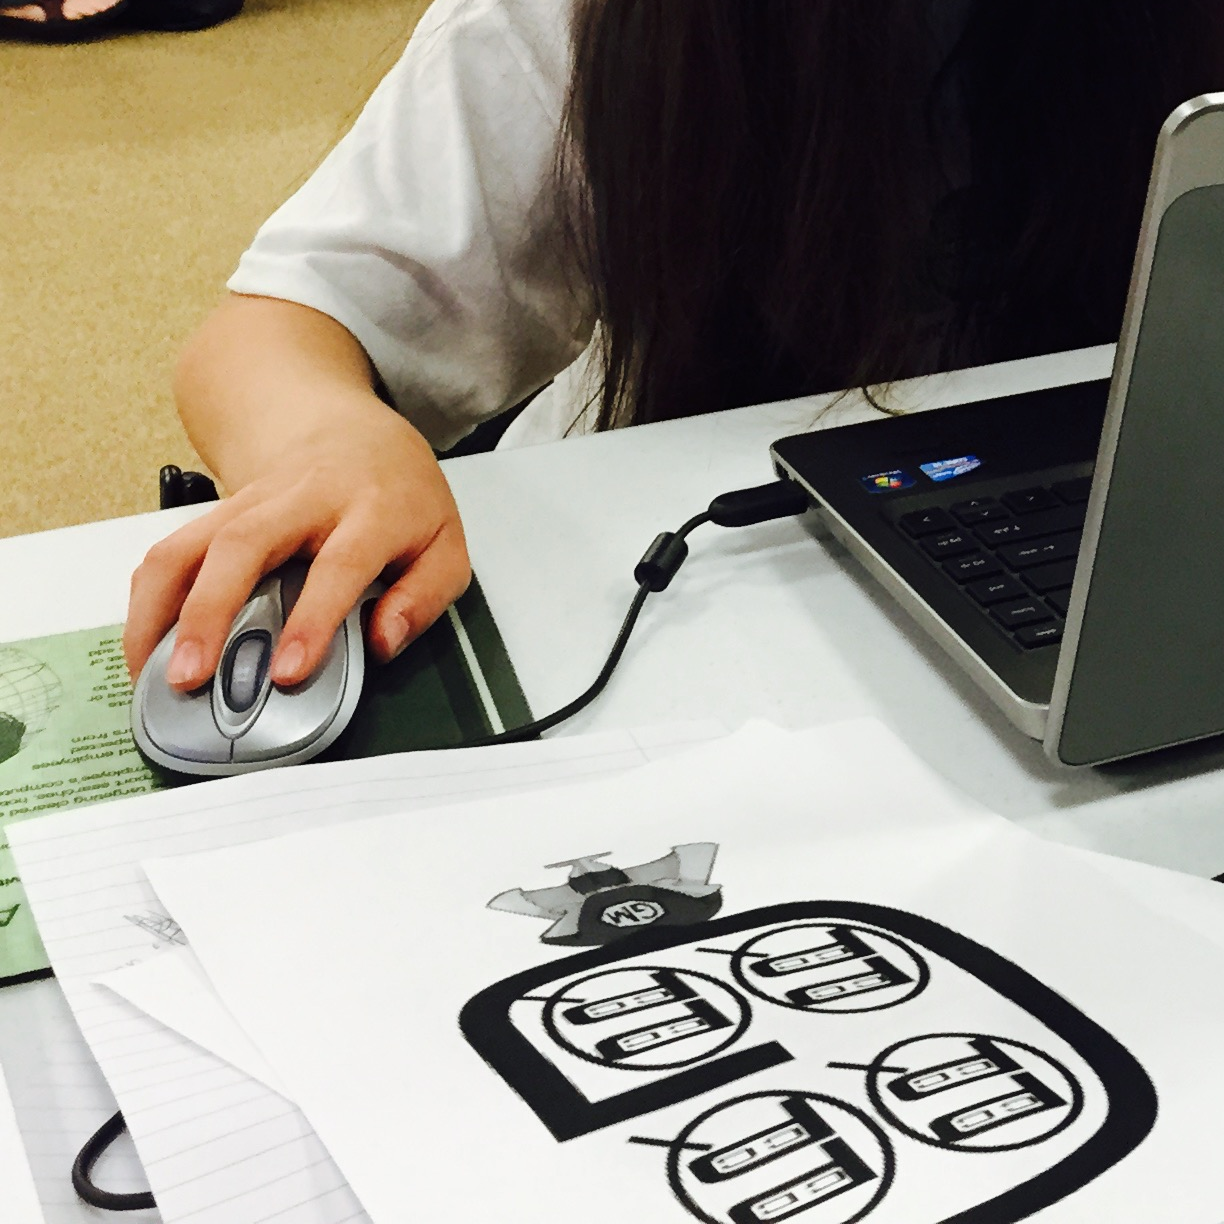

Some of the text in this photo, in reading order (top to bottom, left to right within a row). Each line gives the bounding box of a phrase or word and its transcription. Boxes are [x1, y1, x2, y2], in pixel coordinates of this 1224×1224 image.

[71, 733, 108, 744] from
[32, 750, 113, 770] employees
[9, 786, 146, 817] targeting cleared
[606, 903, 659, 925] GM
